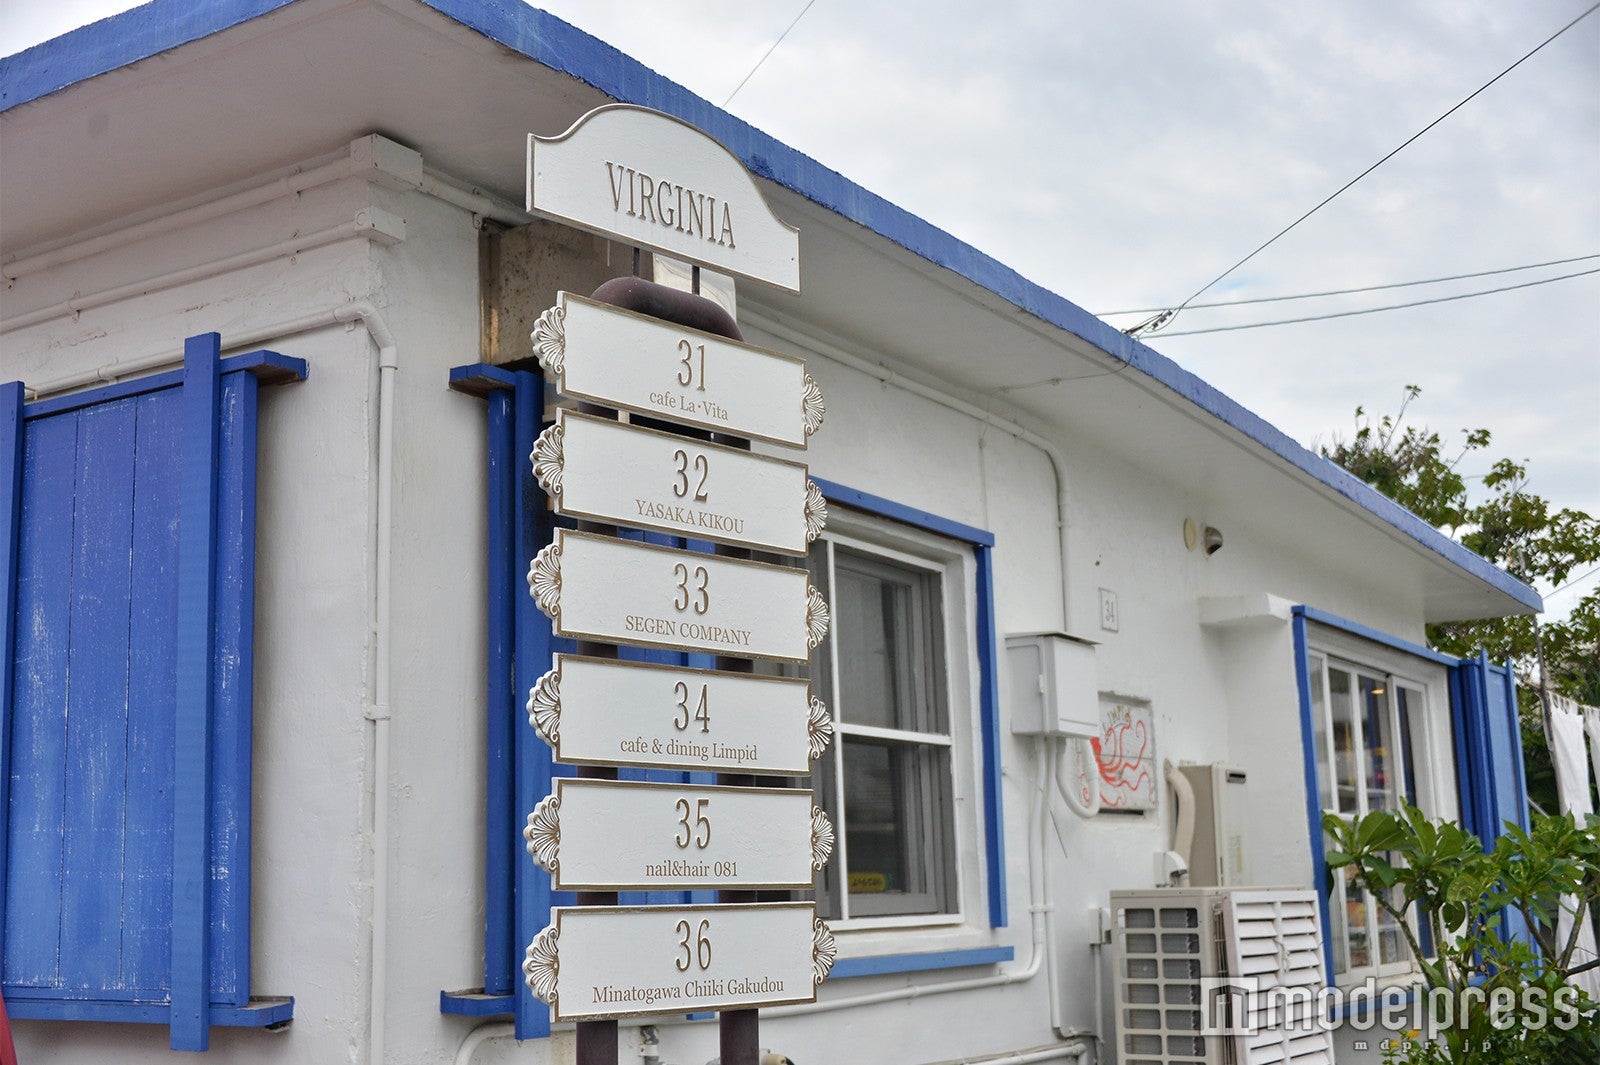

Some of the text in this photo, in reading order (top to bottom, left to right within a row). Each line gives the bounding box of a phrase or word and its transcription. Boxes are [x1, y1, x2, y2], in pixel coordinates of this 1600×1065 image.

[605, 161, 736, 249] VIRGINIA
[677, 339, 706, 392] 31
[650, 391, 677, 408] cafe
[673, 449, 709, 503] 32
[635, 499, 745, 534] YASAKA KIKOU
[674, 563, 710, 615] 33
[625, 615, 751, 646] SEGEN COMPANY
[674, 681, 710, 733] 34
[620, 736, 758, 764] cafe & dining Limpid
[675, 798, 711, 850] 35
[646, 859, 738, 877] nail&hair 081
[675, 918, 712, 972] 36
[592, 976, 785, 1005] Minatogawa Chiiki Gakudou
